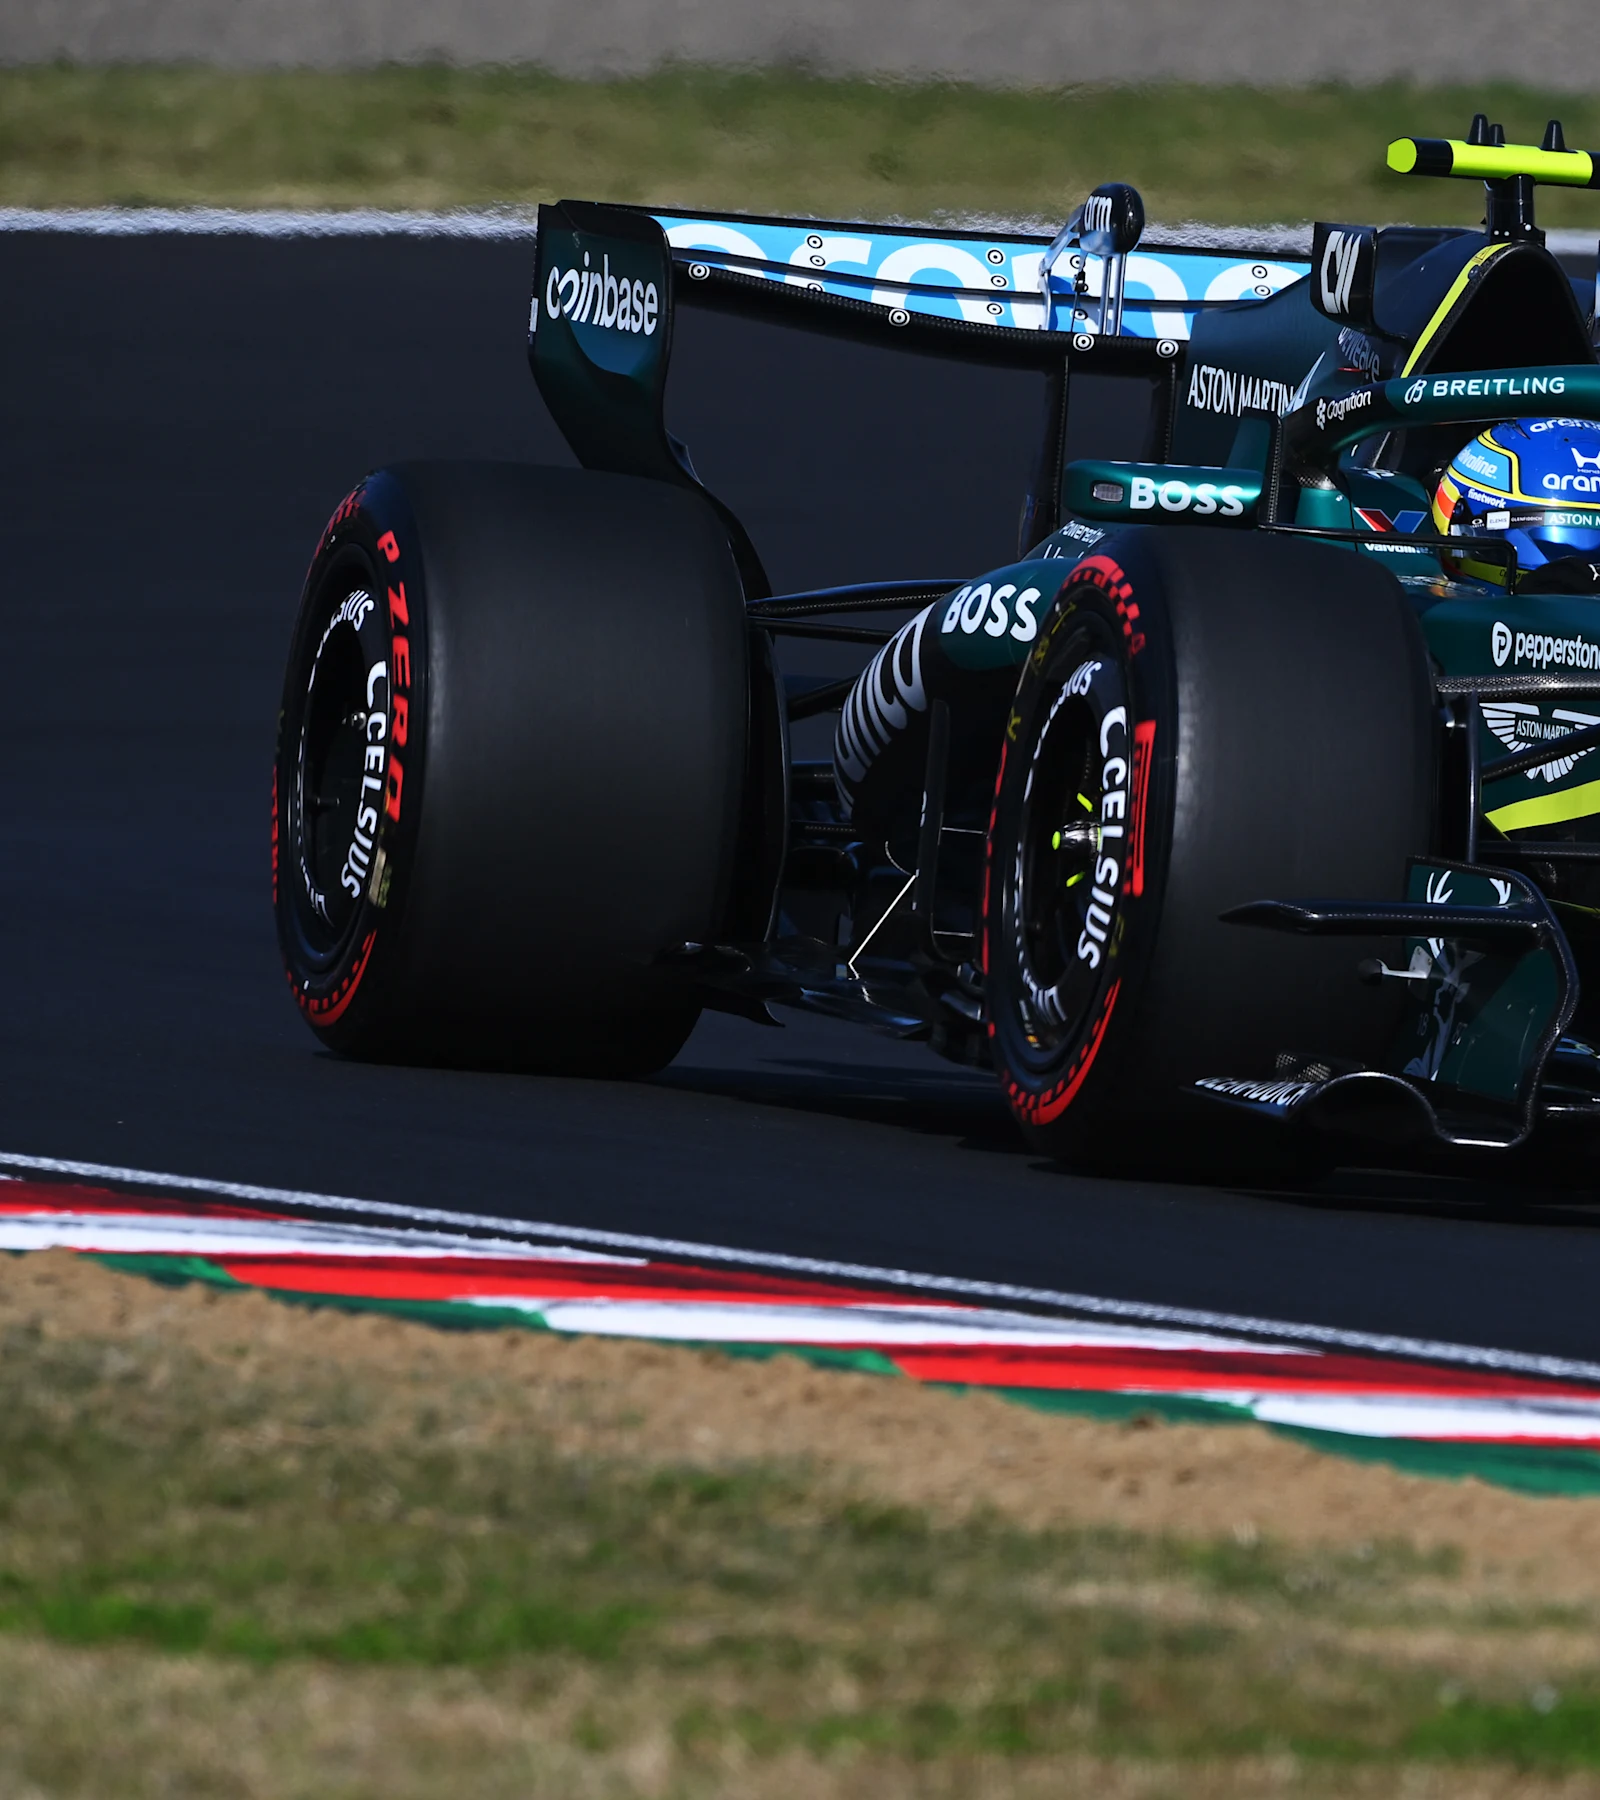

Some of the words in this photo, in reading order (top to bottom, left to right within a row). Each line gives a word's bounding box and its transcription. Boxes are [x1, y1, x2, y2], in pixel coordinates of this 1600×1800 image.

[1084, 195, 1114, 233] arm
[545, 251, 659, 336] coinbase
[1187, 363, 1236, 417] ASTON
[1236, 370, 1296, 418] MARTIN
[1433, 377, 1565, 397] BREITLING
[1129, 477, 1245, 517] BOSS
[1467, 488, 1506, 510] finetwork
[1550, 512, 1593, 527] ASTON
[377, 530, 400, 565] P
[941, 583, 1042, 642] BOSS
[1516, 719, 1542, 739] ASTON
[340, 711, 387, 900] CELSIUS
[1077, 757, 1127, 970] CELSIUS
